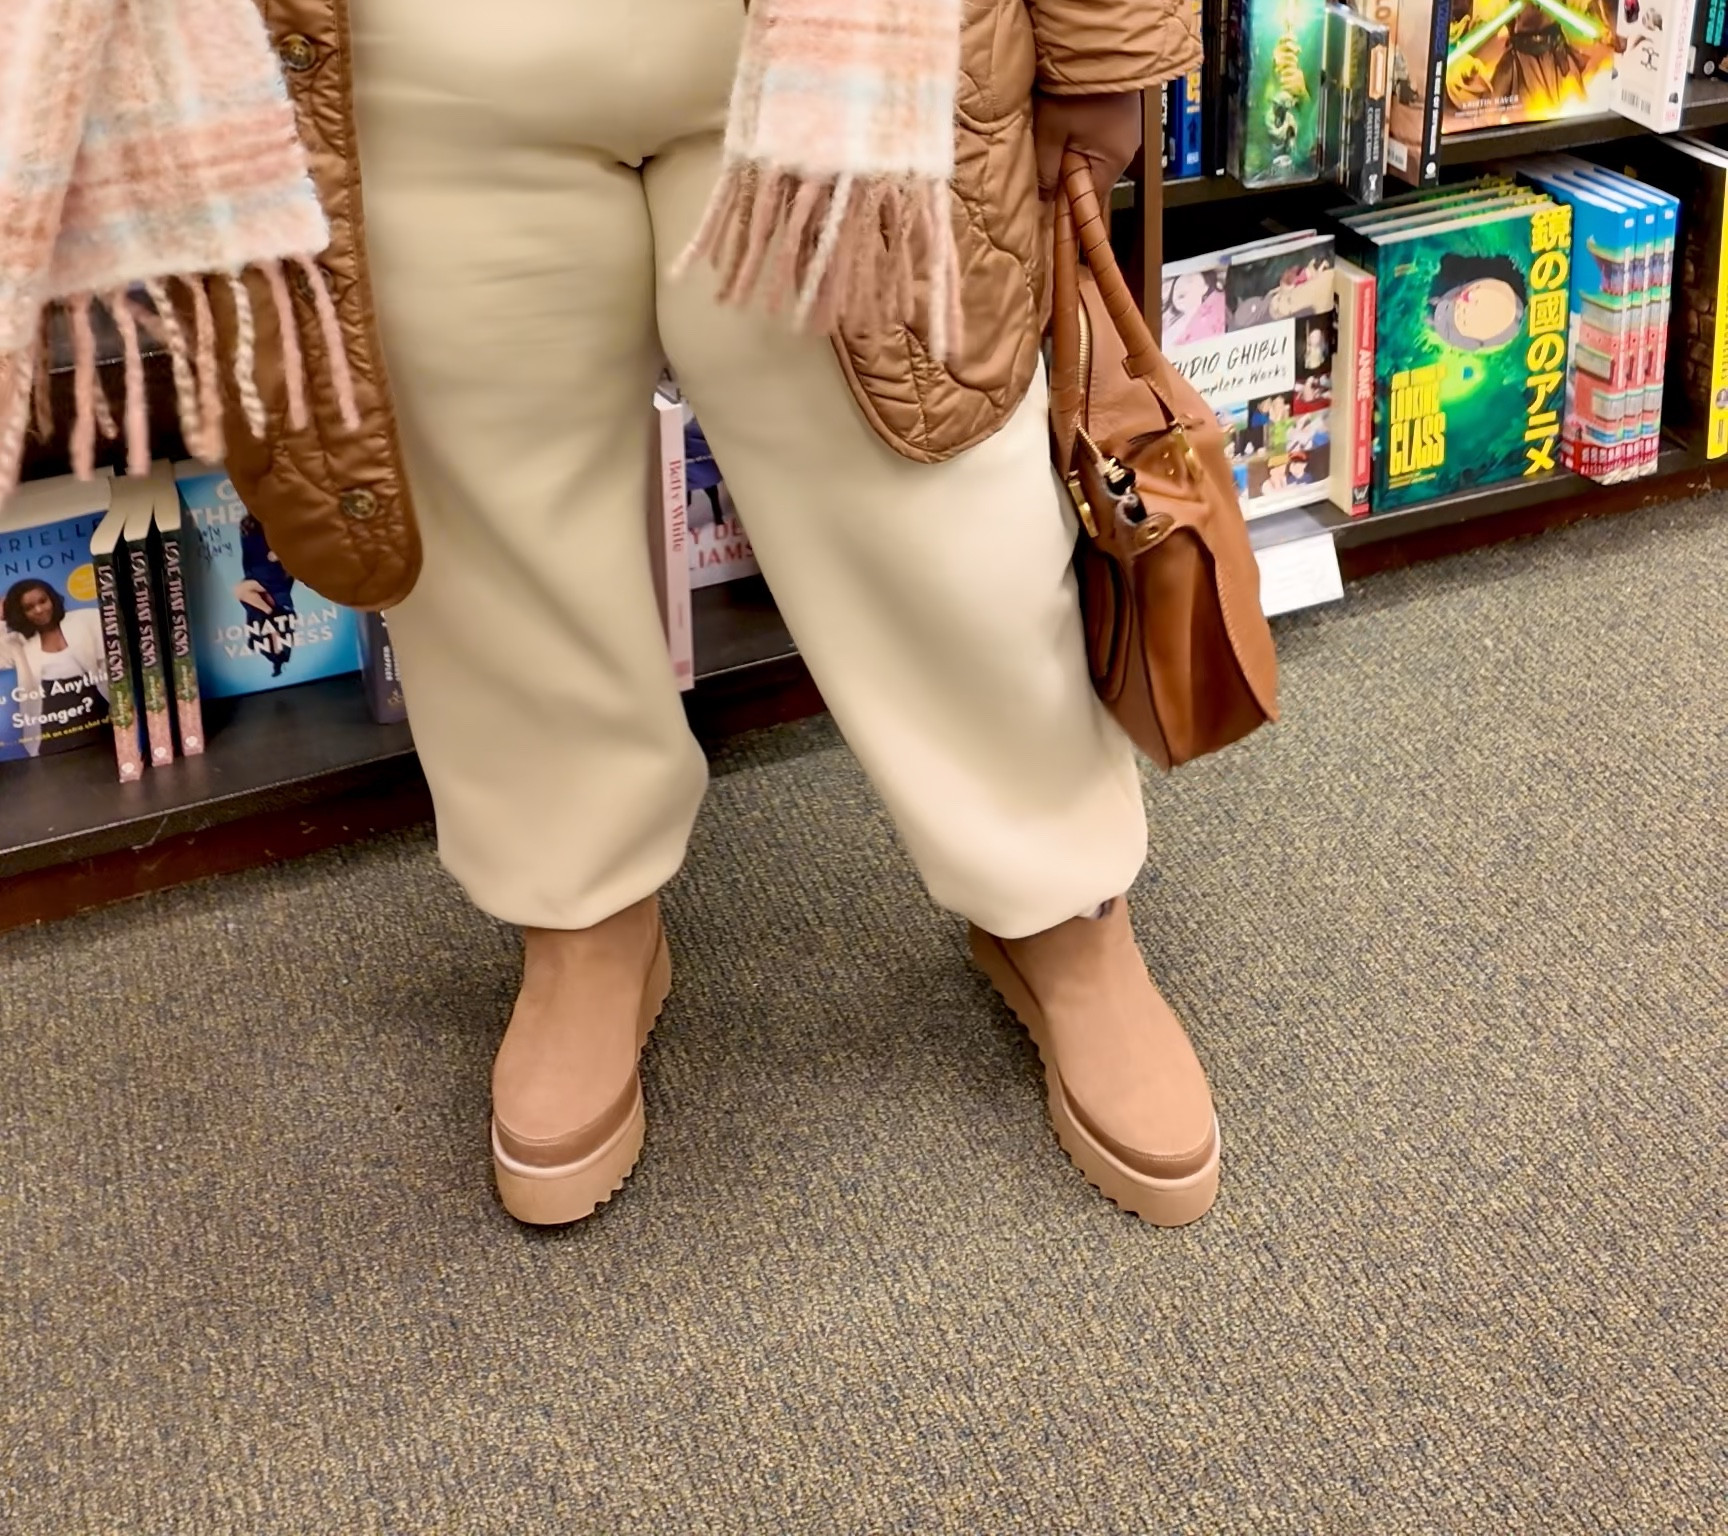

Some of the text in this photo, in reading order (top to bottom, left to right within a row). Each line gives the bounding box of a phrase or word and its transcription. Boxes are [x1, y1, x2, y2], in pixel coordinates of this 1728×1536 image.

[1227, 336, 1289, 371] GHIBLI
[1249, 369, 1287, 386] Works
[1357, 349, 1372, 401] ANIME
[1390, 411, 1446, 476] GLASS
[669, 460, 686, 552] Betty White
[4, 549, 75, 576] NION
[130, 551, 147, 589] LOVE
[165, 541, 182, 578] LOVE
[98, 565, 117, 601] LOVE
[169, 580, 186, 613] THAT
[103, 604, 121, 637] THAT
[135, 590, 151, 622] THAT
[215, 606, 338, 644] JONATHAN
[224, 625, 333, 659] VAN NESS
[11, 687, 46, 703] Got
[12, 696, 94, 729] Stronger?
